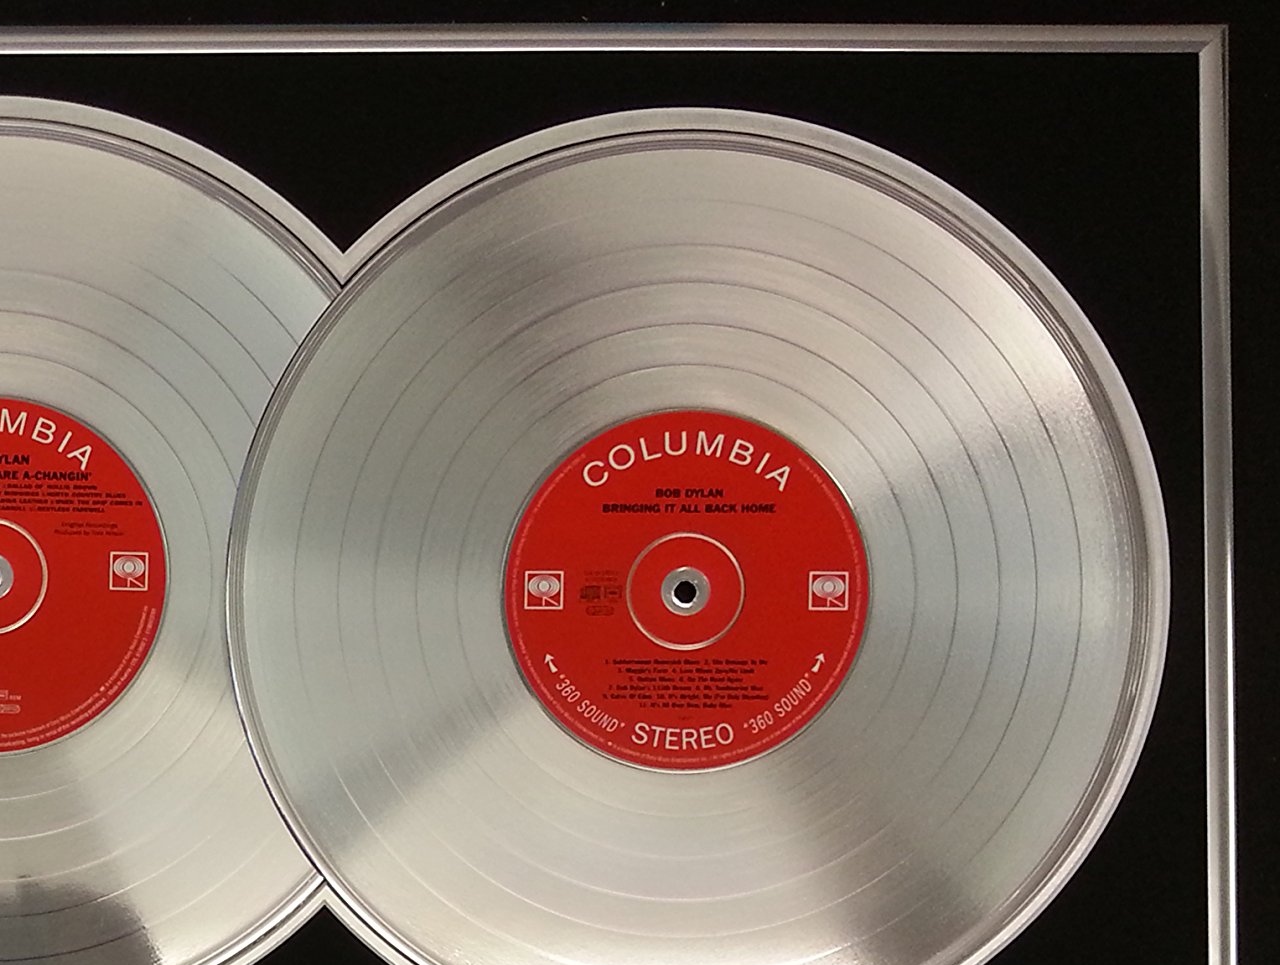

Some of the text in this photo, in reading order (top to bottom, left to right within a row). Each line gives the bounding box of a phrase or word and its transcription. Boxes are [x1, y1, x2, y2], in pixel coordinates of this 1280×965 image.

[582, 431, 791, 492] COLUMBIA
[23, 471, 92, 481] A-CHANGIN'
[655, 488, 724, 498] BOB DYLAN
[602, 503, 776, 513] BRINGING IT ALL BACK HOME
[631, 722, 734, 750] STEREO
